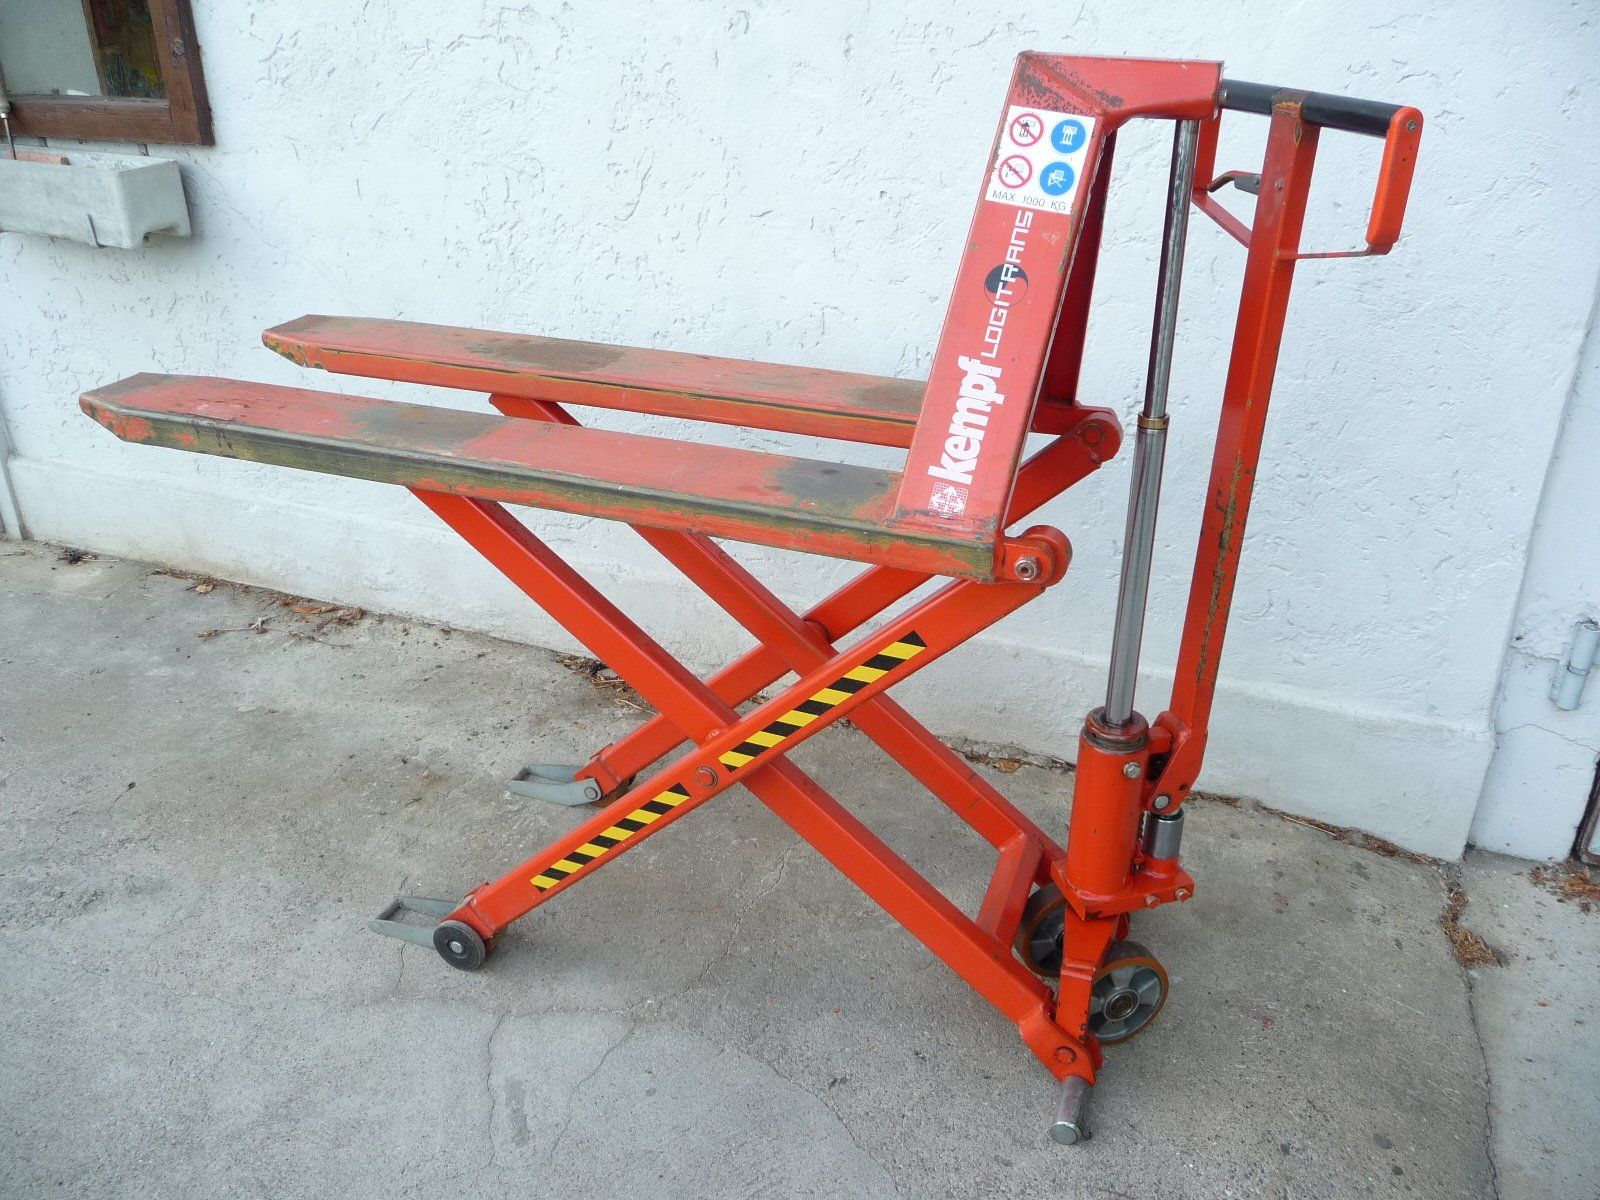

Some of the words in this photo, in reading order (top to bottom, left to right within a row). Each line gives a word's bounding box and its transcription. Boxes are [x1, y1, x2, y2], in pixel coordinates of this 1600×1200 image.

[992, 190, 1015, 202] MAX
[1022, 195, 1045, 207] 1000
[1050, 200, 1066, 211] KG
[981, 210, 1033, 358] LOGITRANS
[927, 355, 1005, 485] kempf
